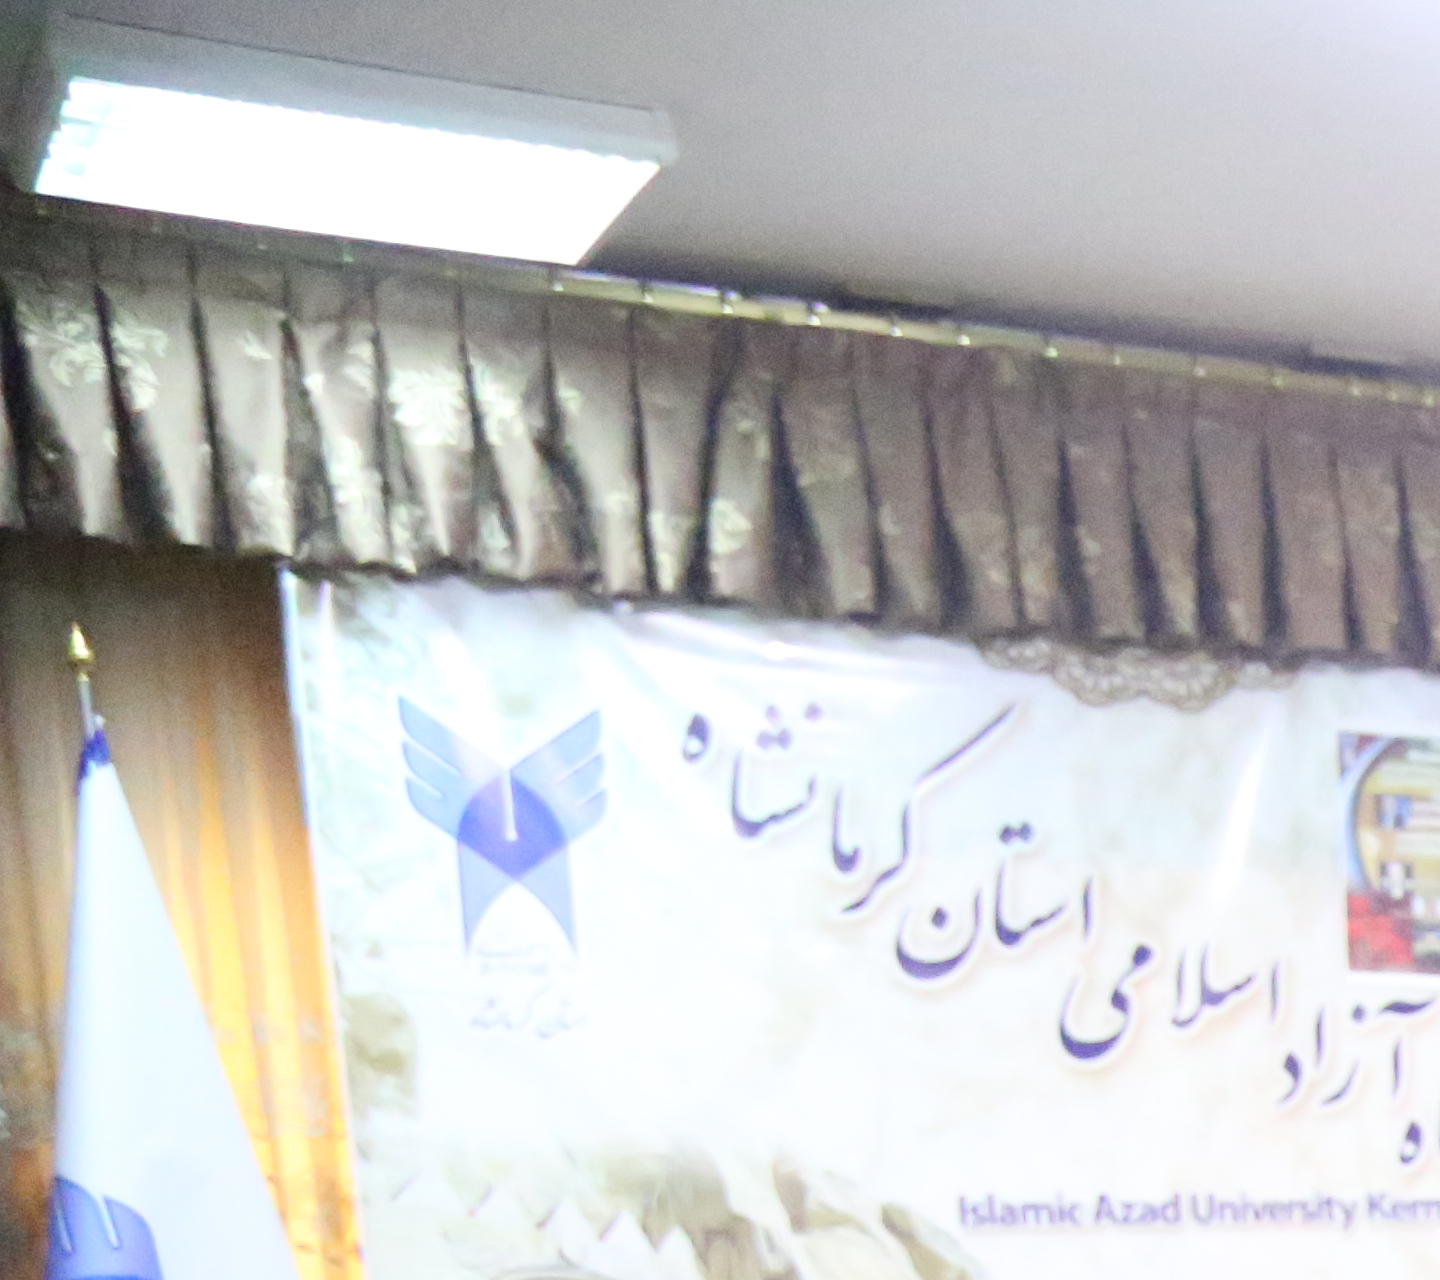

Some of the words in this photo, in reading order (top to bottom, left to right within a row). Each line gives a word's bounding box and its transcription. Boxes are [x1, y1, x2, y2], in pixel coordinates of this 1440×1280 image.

[681, 701, 1017, 914] کرمانشاه
[895, 821, 1094, 979] استان
[1059, 943, 1279, 1060] اسلامی
[1278, 998, 1437, 1105] آزاد
[957, 1193, 1080, 1227] Islamic
[1093, 1192, 1182, 1226] Azad
[1190, 1193, 1356, 1230] University
